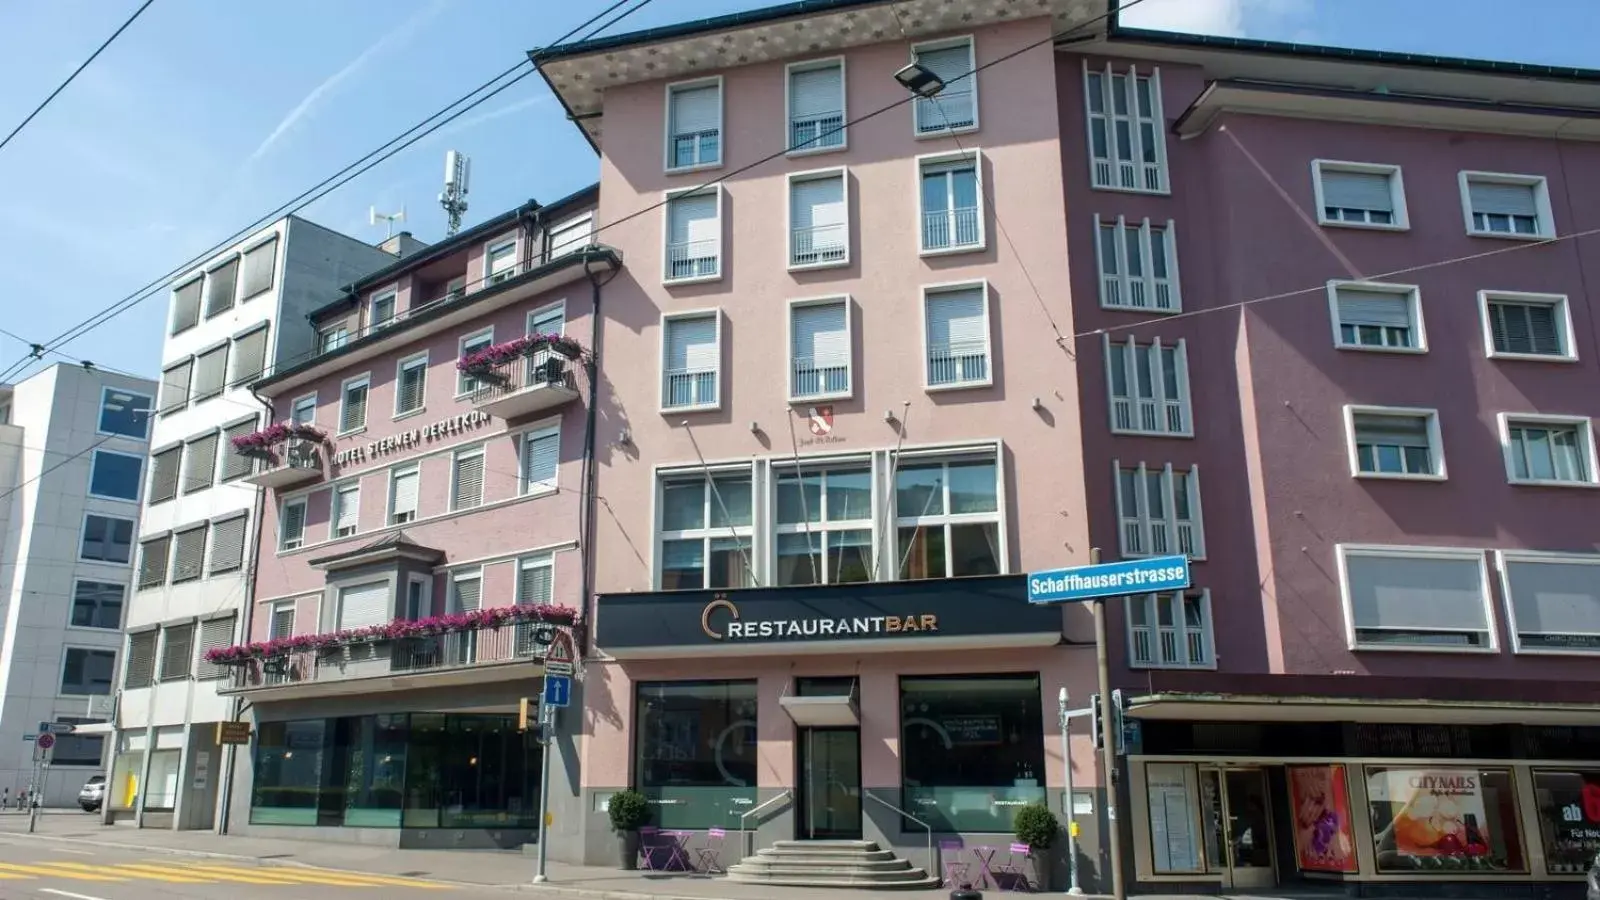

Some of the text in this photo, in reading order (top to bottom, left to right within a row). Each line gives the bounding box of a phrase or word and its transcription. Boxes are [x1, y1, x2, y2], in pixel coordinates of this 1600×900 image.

[331, 410, 488, 465] HOTEL STERNEN OERLIKON
[1031, 565, 1185, 595] Schaffhauserstrasse
[1562, 803, 1582, 822] ab
